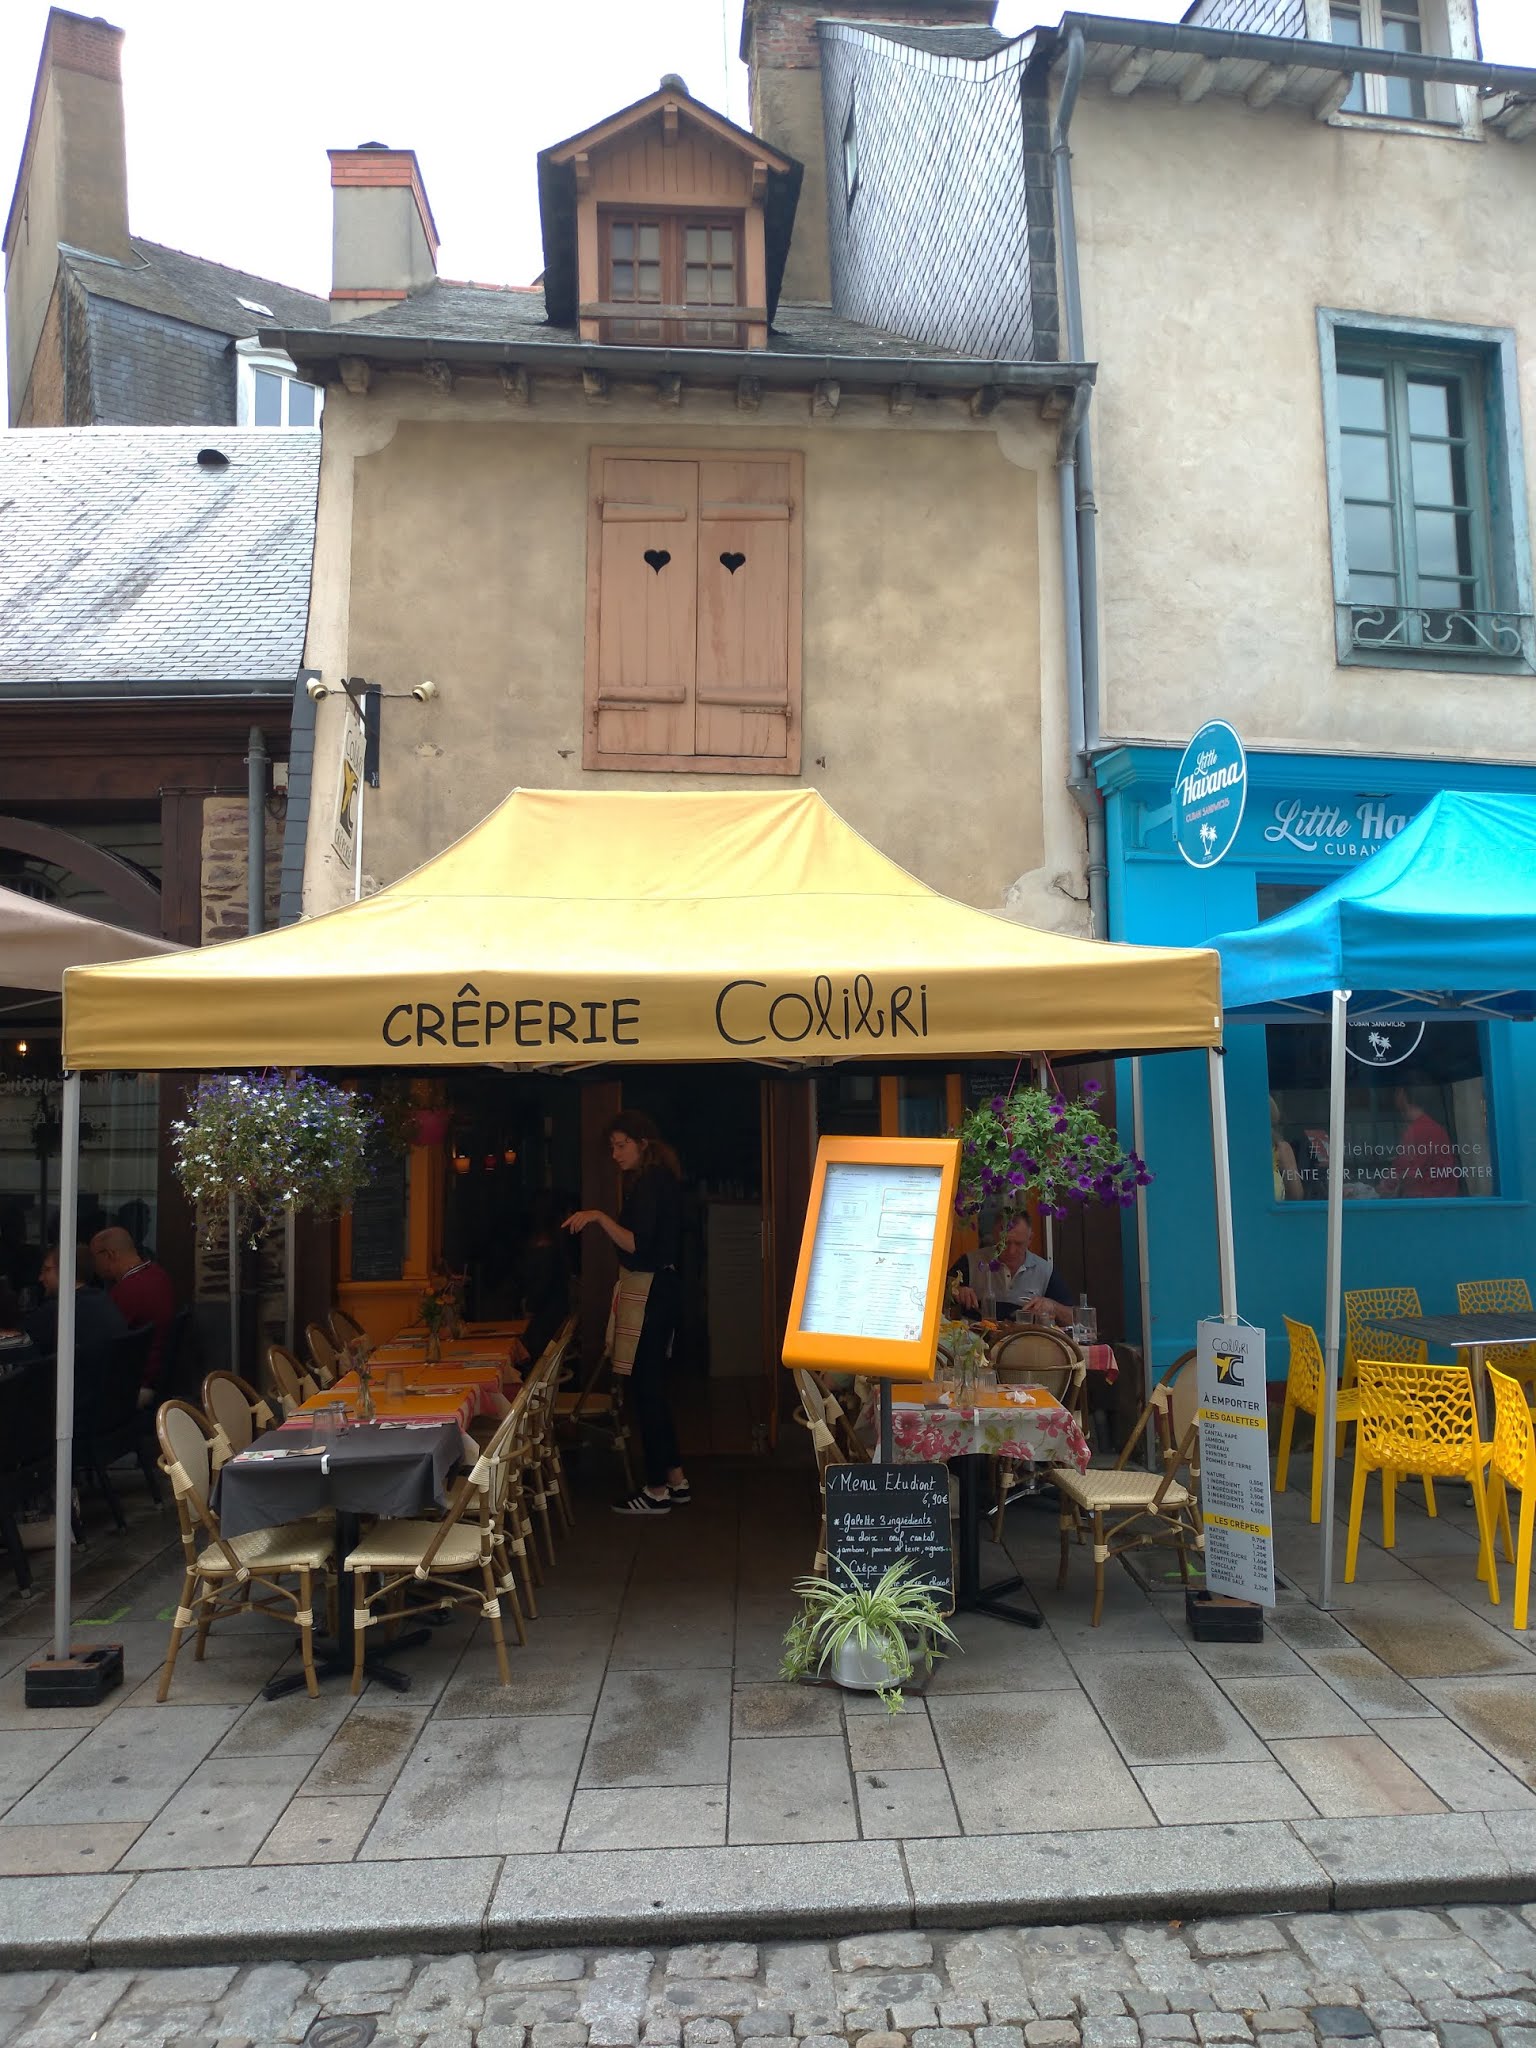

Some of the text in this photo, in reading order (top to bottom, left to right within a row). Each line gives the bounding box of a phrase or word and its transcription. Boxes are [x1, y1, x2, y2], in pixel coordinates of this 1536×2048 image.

[1194, 748, 1218, 776] Little
[1177, 761, 1243, 806] Havana
[1264, 798, 1352, 852] Little
[382, 982, 641, 1048] CRÊPERIE
[1278, 1168, 1319, 1181] VENTE
[1326, 1168, 1350, 1180] SR
[1358, 1168, 1397, 1180] PLACE
[1414, 1167, 1424, 1179] A
[1430, 1166, 1493, 1179] EMPORTER
[1212, 1395, 1260, 1411] EMPORTER
[1205, 1411, 1260, 1427] LES GALETTES
[840, 1472, 936, 1491] Menu Etudiant
[922, 1493, 949, 1508] 6,90€
[843, 1513, 875, 1533] Galette
[880, 1515, 885, 1525] 3
[1214, 1517, 1260, 1533] LES CRÊPES
[858, 1531, 878, 1541] choix
[849, 1560, 878, 1579] Crêpe
